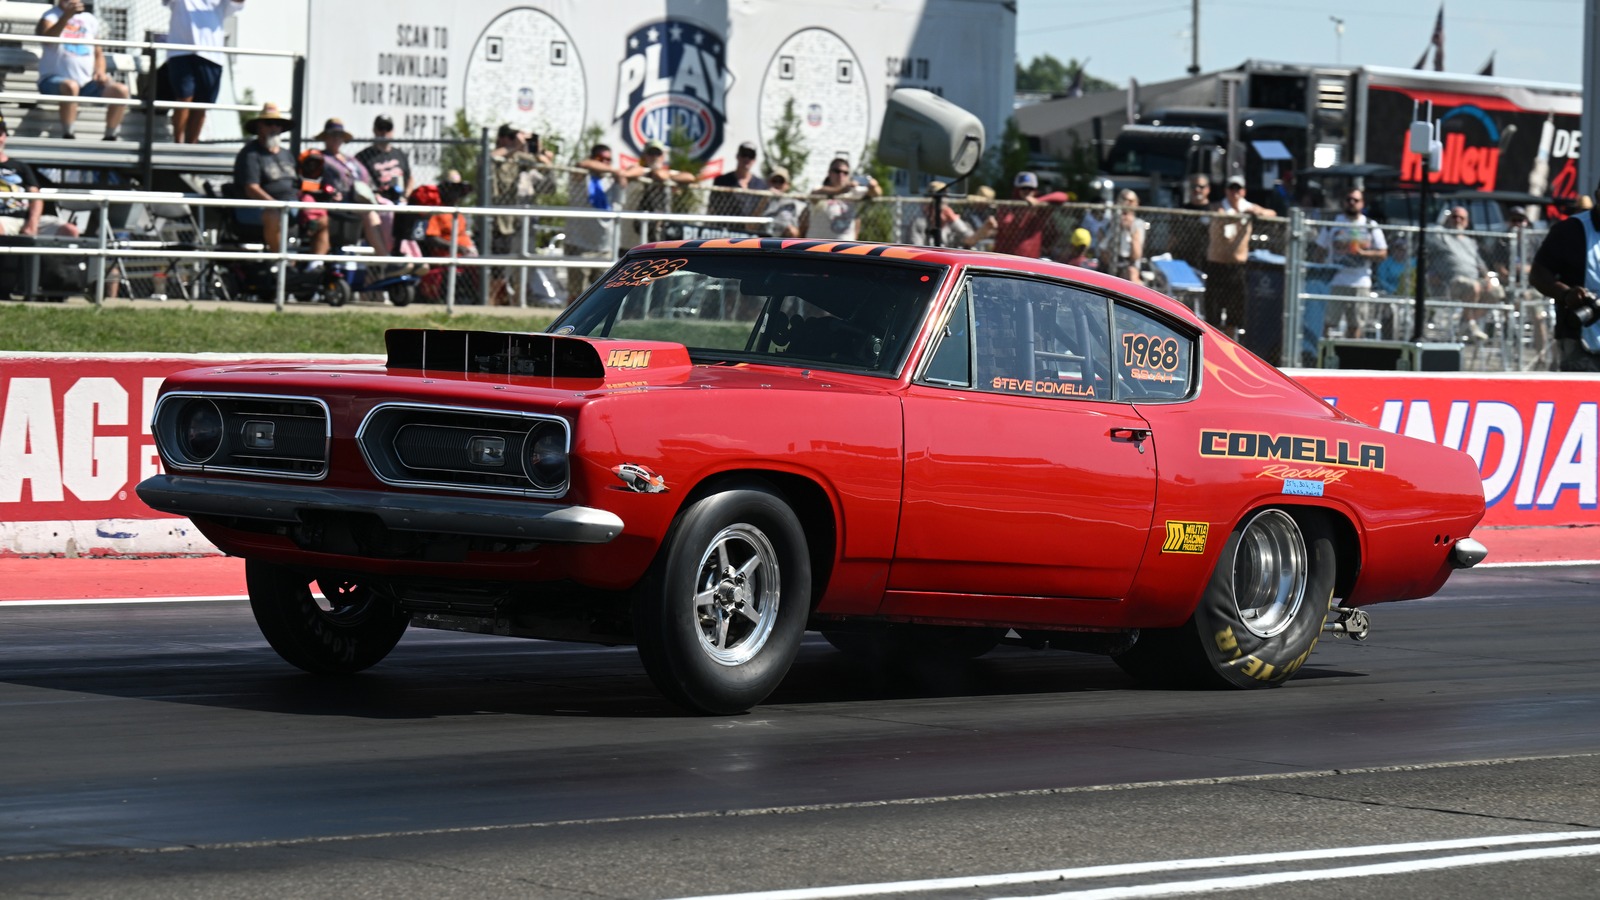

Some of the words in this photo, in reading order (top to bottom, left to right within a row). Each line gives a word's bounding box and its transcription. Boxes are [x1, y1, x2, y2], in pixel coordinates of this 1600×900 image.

[396, 24, 429, 47] SCAN
[434, 26, 448, 49] TO
[378, 53, 448, 78] DOWNLOAD
[613, 42, 735, 120] PLAY
[351, 81, 384, 105] YOUR
[388, 83, 447, 109] FAVORITE
[404, 114, 427, 138] APP
[606, 258, 689, 284] 1968
[606, 349, 652, 369] HEMI
[1122, 333, 1179, 372] 1968
[992, 376, 1034, 392] STEVE
[1035, 381, 1095, 397] COMELLA
[1199, 428, 1386, 472] COMELLA
[1255, 464, 1349, 485] Racing
[1183, 534, 1206, 544] RACING
[1185, 524, 1207, 535] MILITIA
